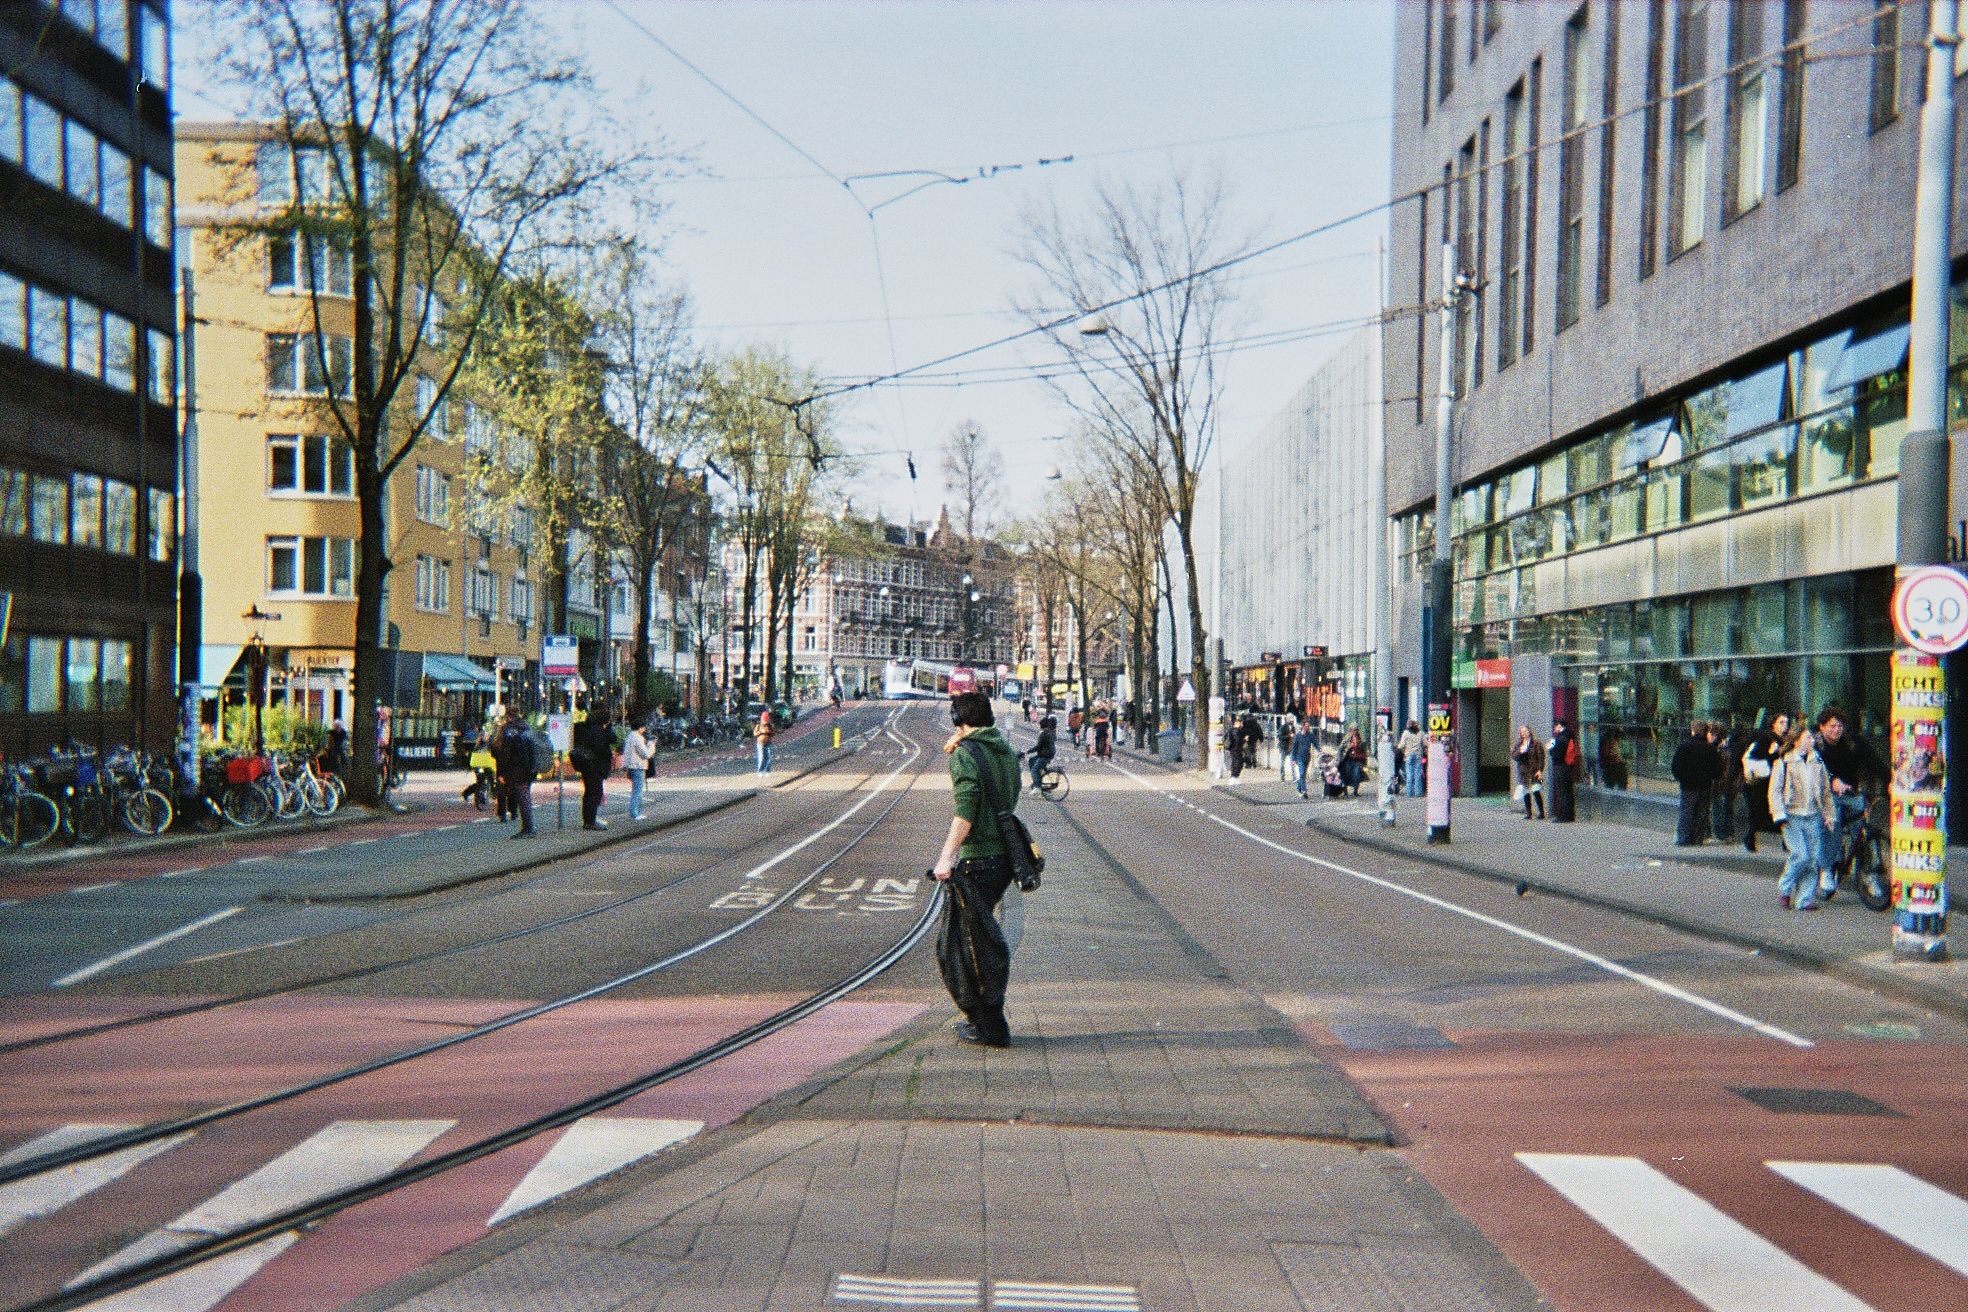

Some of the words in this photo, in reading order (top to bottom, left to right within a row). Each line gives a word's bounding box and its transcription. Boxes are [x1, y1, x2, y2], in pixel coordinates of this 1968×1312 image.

[1913, 597, 1961, 624] 30
[1895, 677, 1938, 690] ECHT
[1428, 716, 1451, 730] OV
[1893, 838, 1934, 853] ECHT
